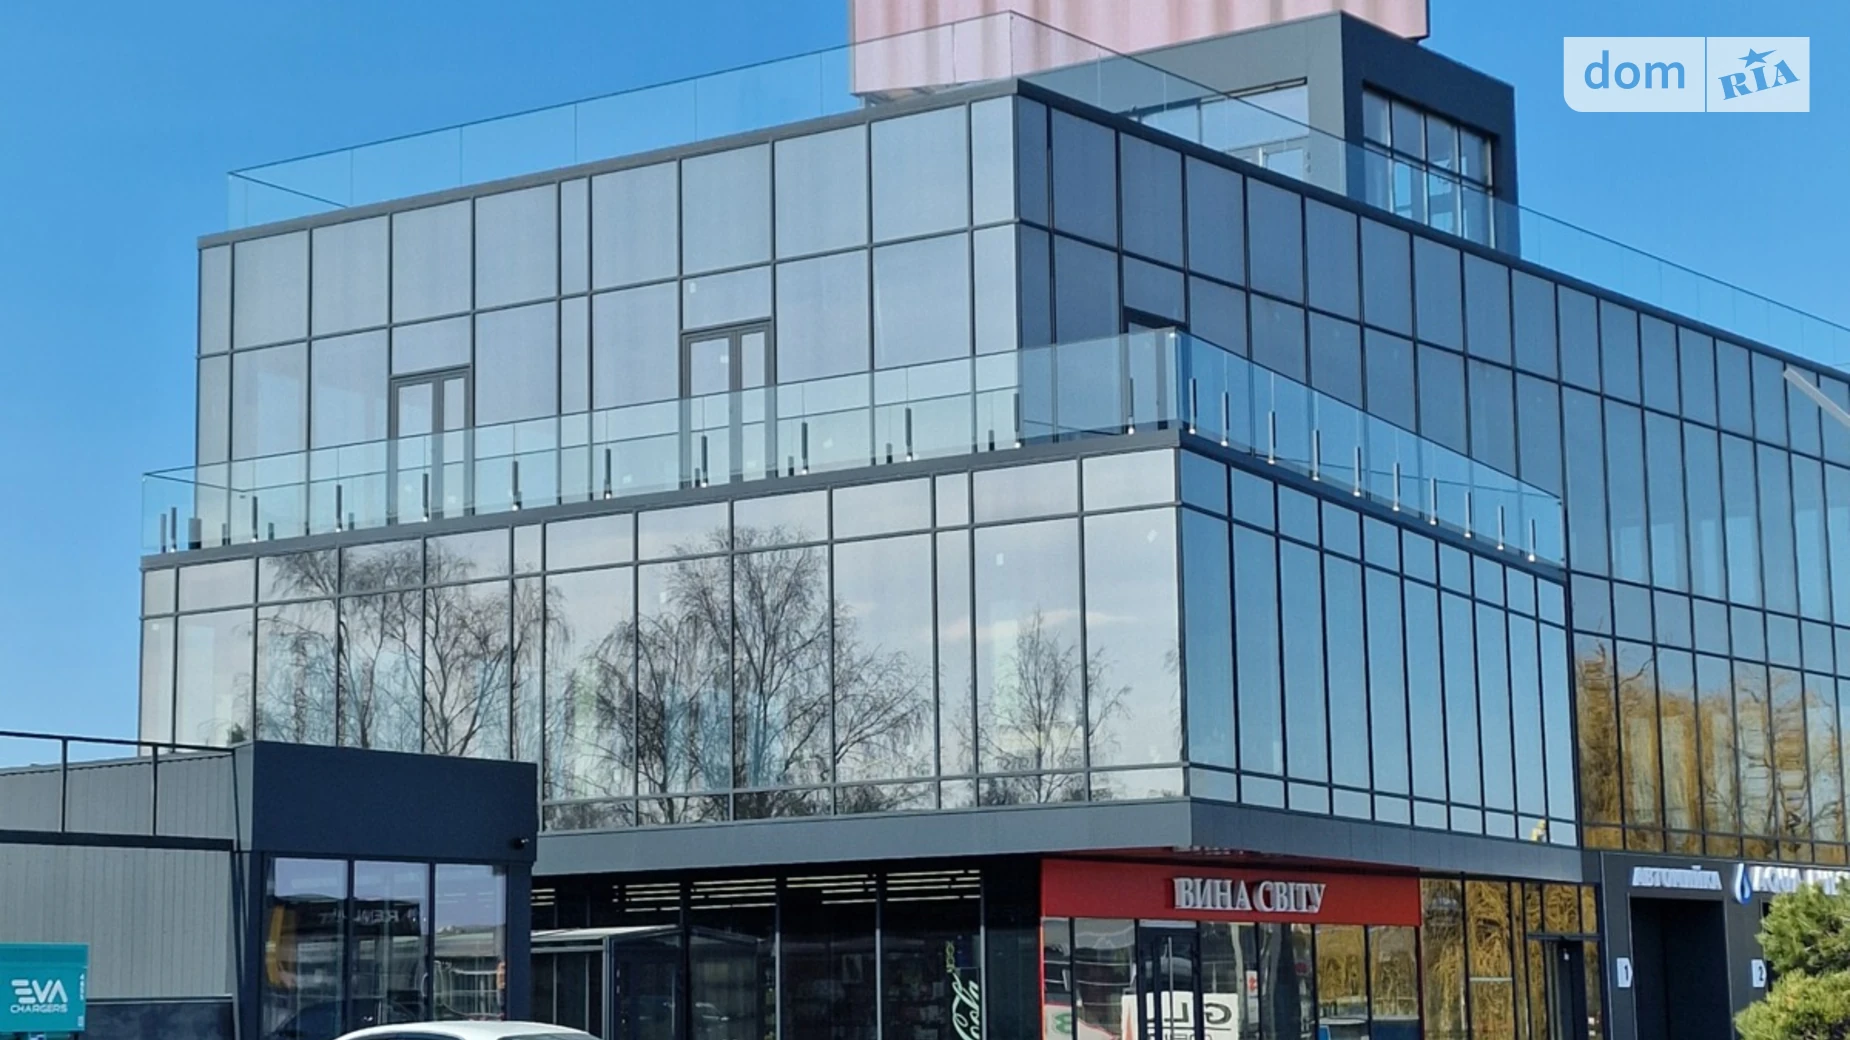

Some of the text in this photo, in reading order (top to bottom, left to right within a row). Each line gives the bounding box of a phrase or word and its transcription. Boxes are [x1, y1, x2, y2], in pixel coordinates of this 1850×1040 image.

[1173, 877, 1326, 914] ВИНА СВІТУ
[1623, 964, 1630, 982] 1
[1757, 965, 1765, 982] 2
[11, 978, 69, 1005] EVA
[10, 1004, 68, 1014] CHARGERS
